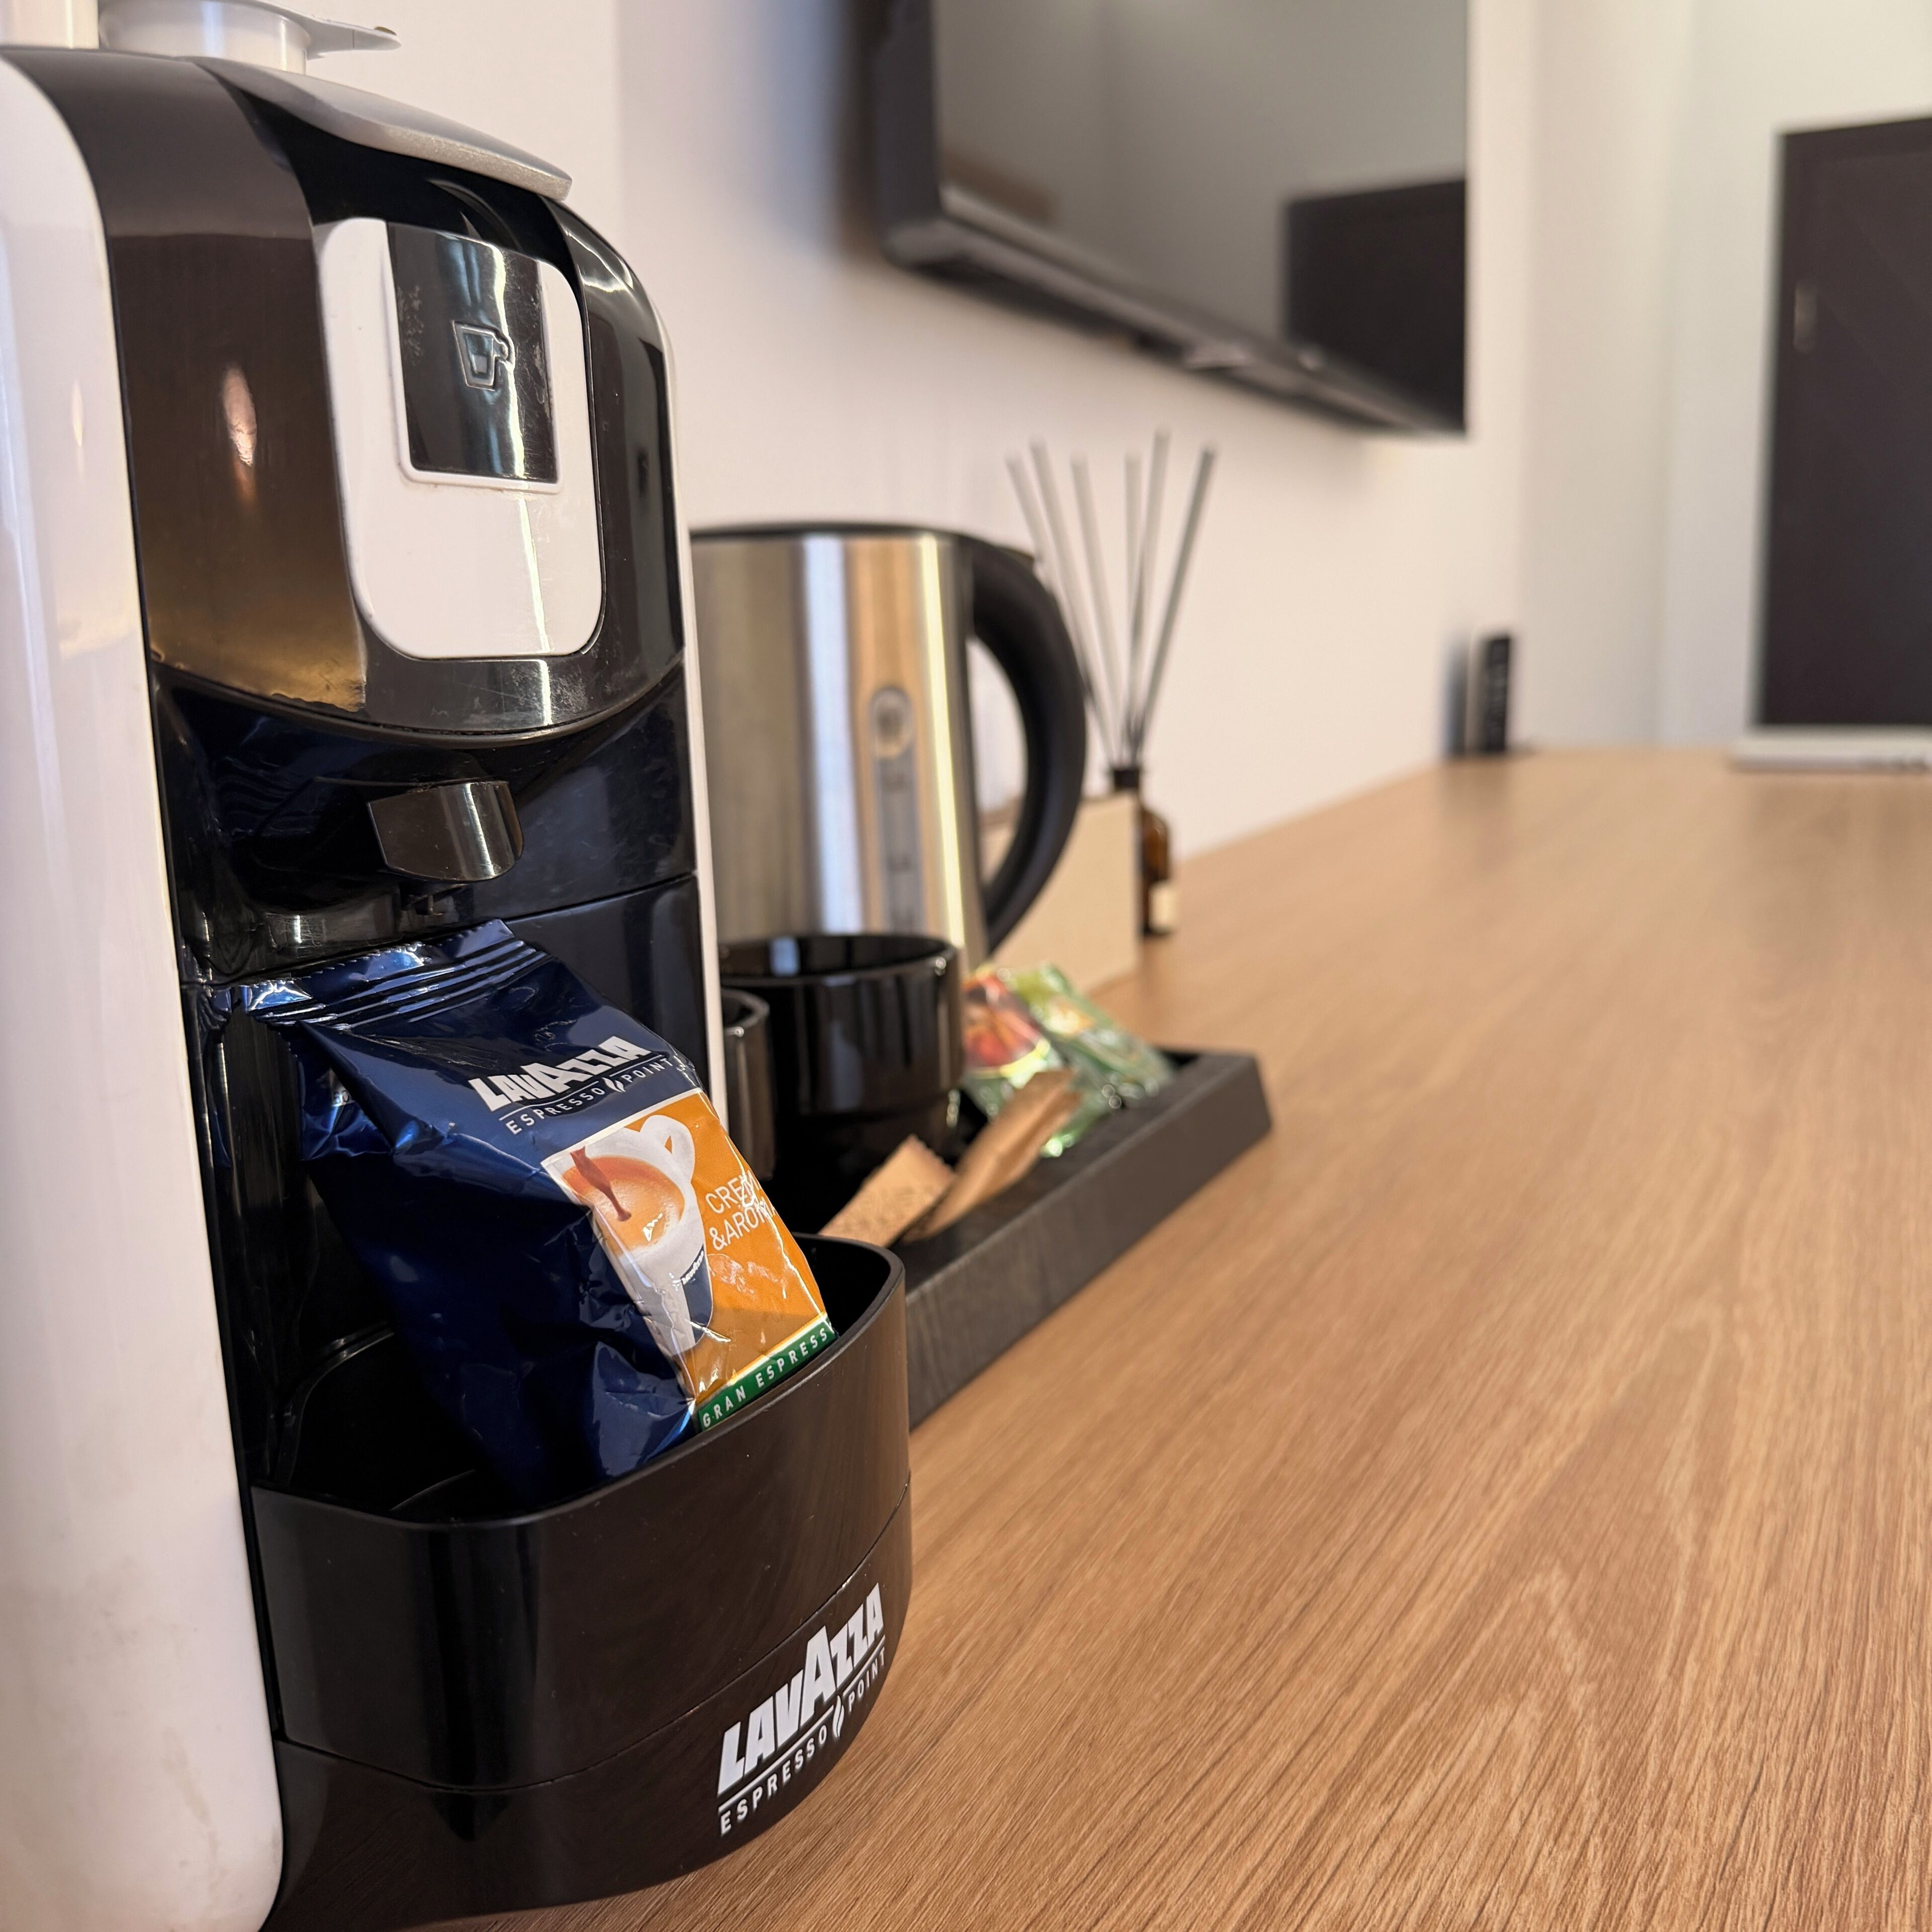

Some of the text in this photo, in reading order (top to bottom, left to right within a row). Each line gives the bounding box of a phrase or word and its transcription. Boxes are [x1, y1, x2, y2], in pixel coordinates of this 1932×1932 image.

[468, 1036, 652, 1111] LAVAZZA
[506, 1058, 673, 1135] ESPRESSO POINT
[705, 1169, 762, 1214] CREM
[703, 1325, 829, 1427] GRAN ESPRESS
[717, 1582, 884, 1795] LAVAZZA
[720, 1646, 886, 1836] ESPRESSO POINT
